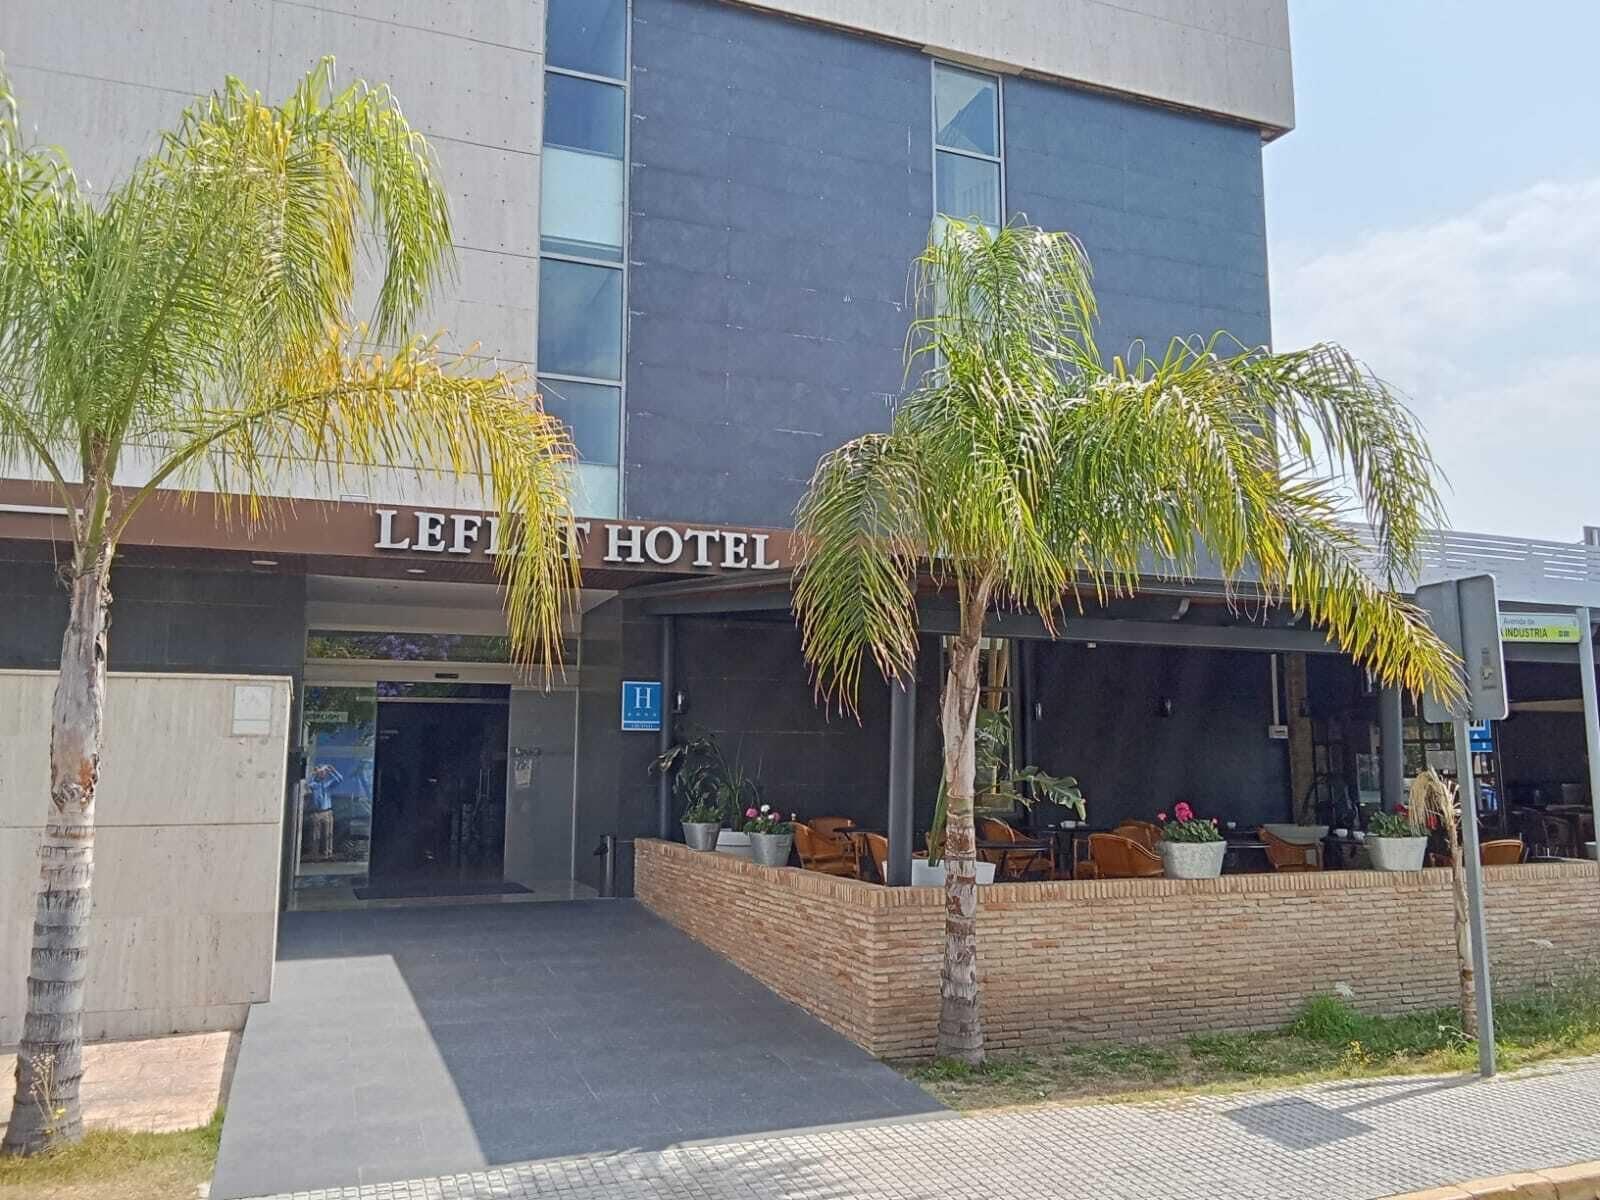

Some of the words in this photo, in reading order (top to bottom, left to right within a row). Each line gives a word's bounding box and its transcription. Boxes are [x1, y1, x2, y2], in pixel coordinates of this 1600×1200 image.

[374, 509, 591, 560] LEFLT
[603, 524, 780, 570] HOTEL
[1504, 627, 1548, 638] INDUSTRIA
[634, 687, 652, 709] H
